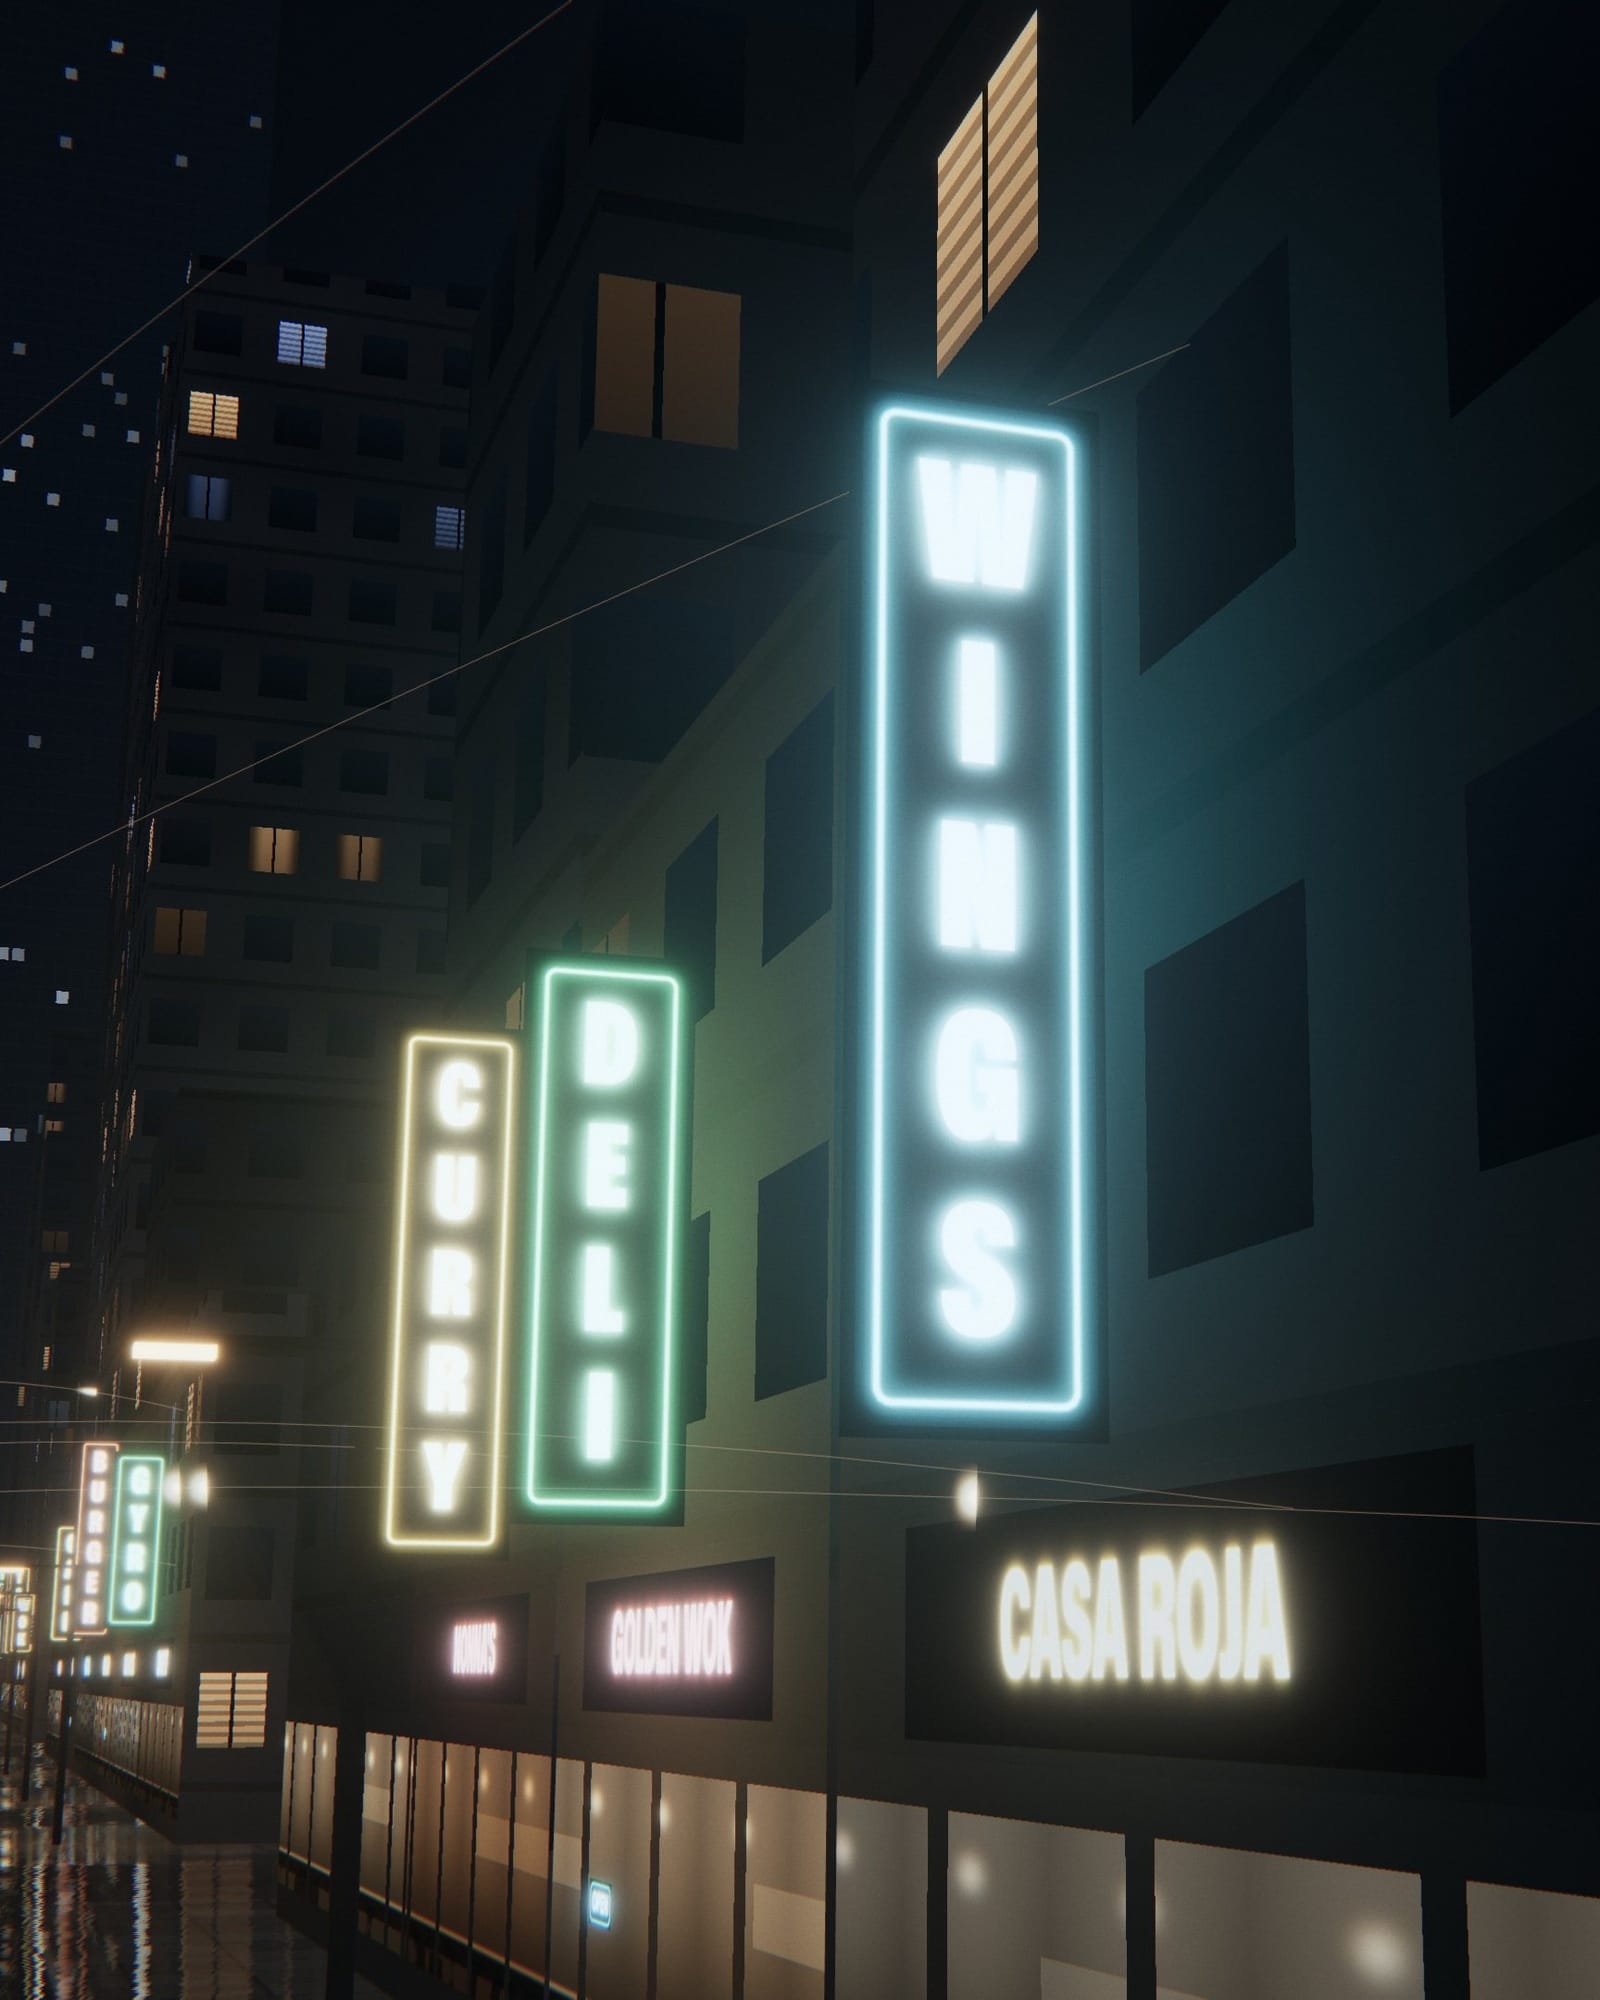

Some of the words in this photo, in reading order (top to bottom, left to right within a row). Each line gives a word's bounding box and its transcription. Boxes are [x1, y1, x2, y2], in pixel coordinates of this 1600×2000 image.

[918, 456, 1039, 1341] WINGS
[420, 1060, 482, 1512] CURRY
[581, 1000, 641, 1461] DELI
[81, 1449, 107, 1625] BURGER
[121, 1464, 152, 1612] GYRO
[1000, 1558, 1128, 1681] CASA
[1139, 1544, 1290, 1681] ROJA
[611, 1604, 681, 1676] GOLDEN
[683, 1600, 734, 1675] WOK
